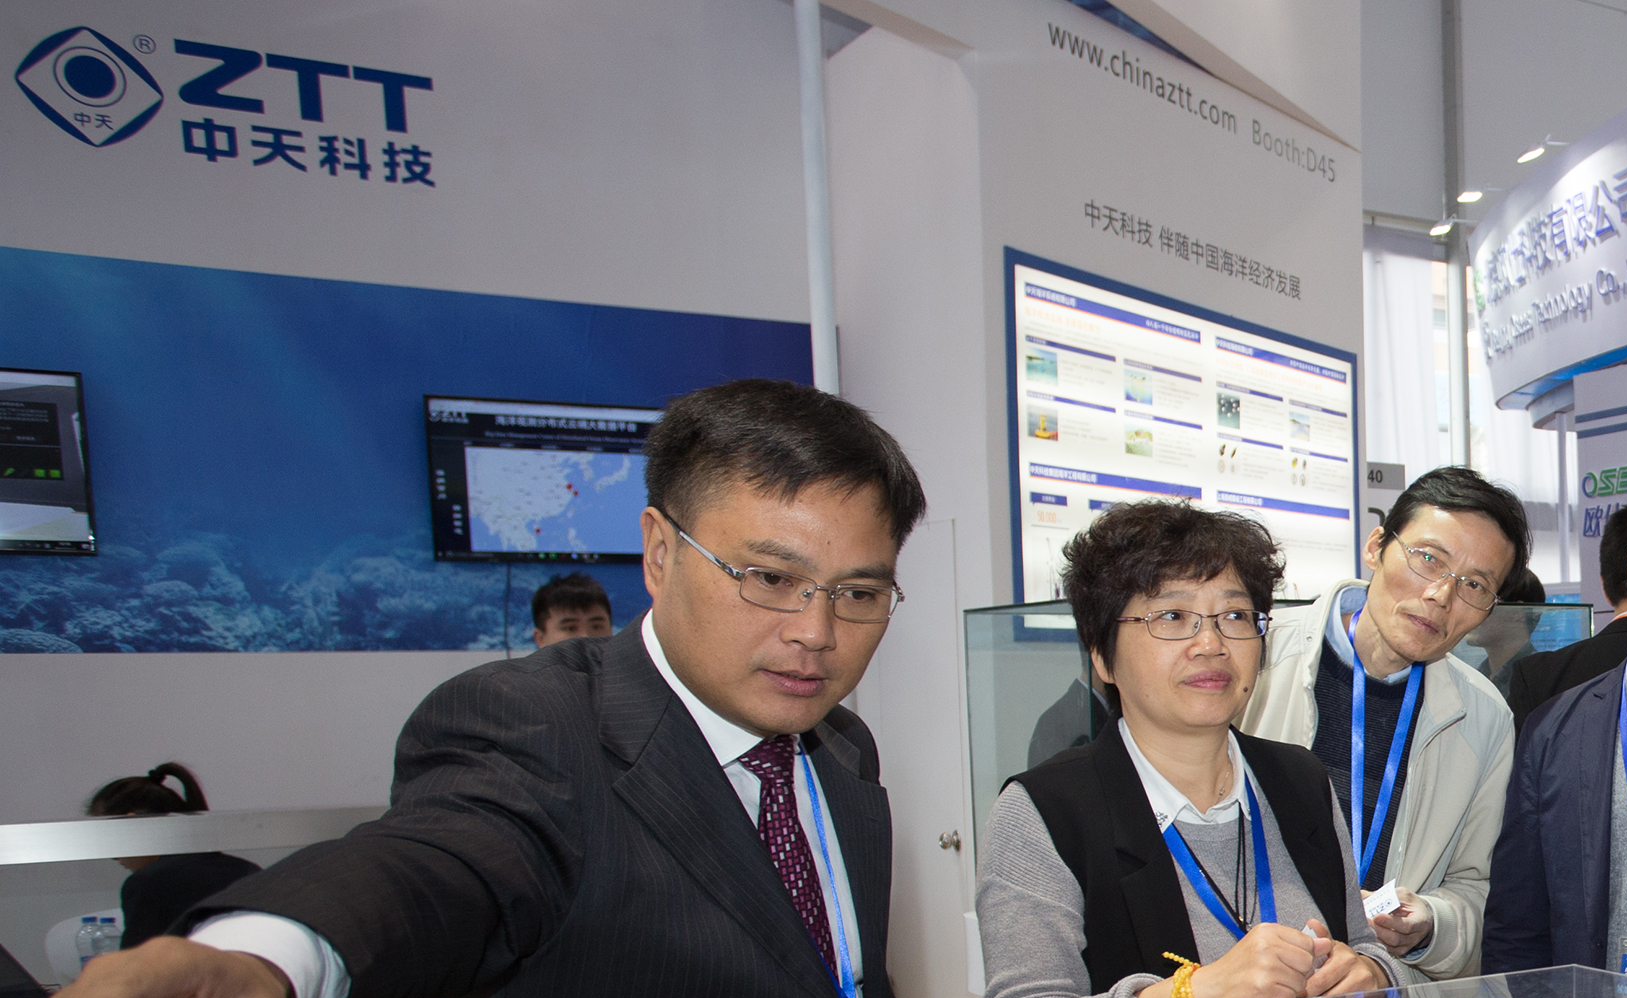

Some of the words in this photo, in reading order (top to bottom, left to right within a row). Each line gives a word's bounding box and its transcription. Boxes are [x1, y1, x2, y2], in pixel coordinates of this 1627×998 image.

[73, 111, 114, 130] 中天
[174, 39, 433, 133] ZTT
[1047, 22, 1238, 135] www.chinaztt.com
[1251, 119, 1336, 183] Booth:D45
[181, 117, 436, 188] 中天科技
[1084, 199, 1153, 249] 中天科技
[1158, 225, 1302, 301] 伴随中国海洋经济发展
